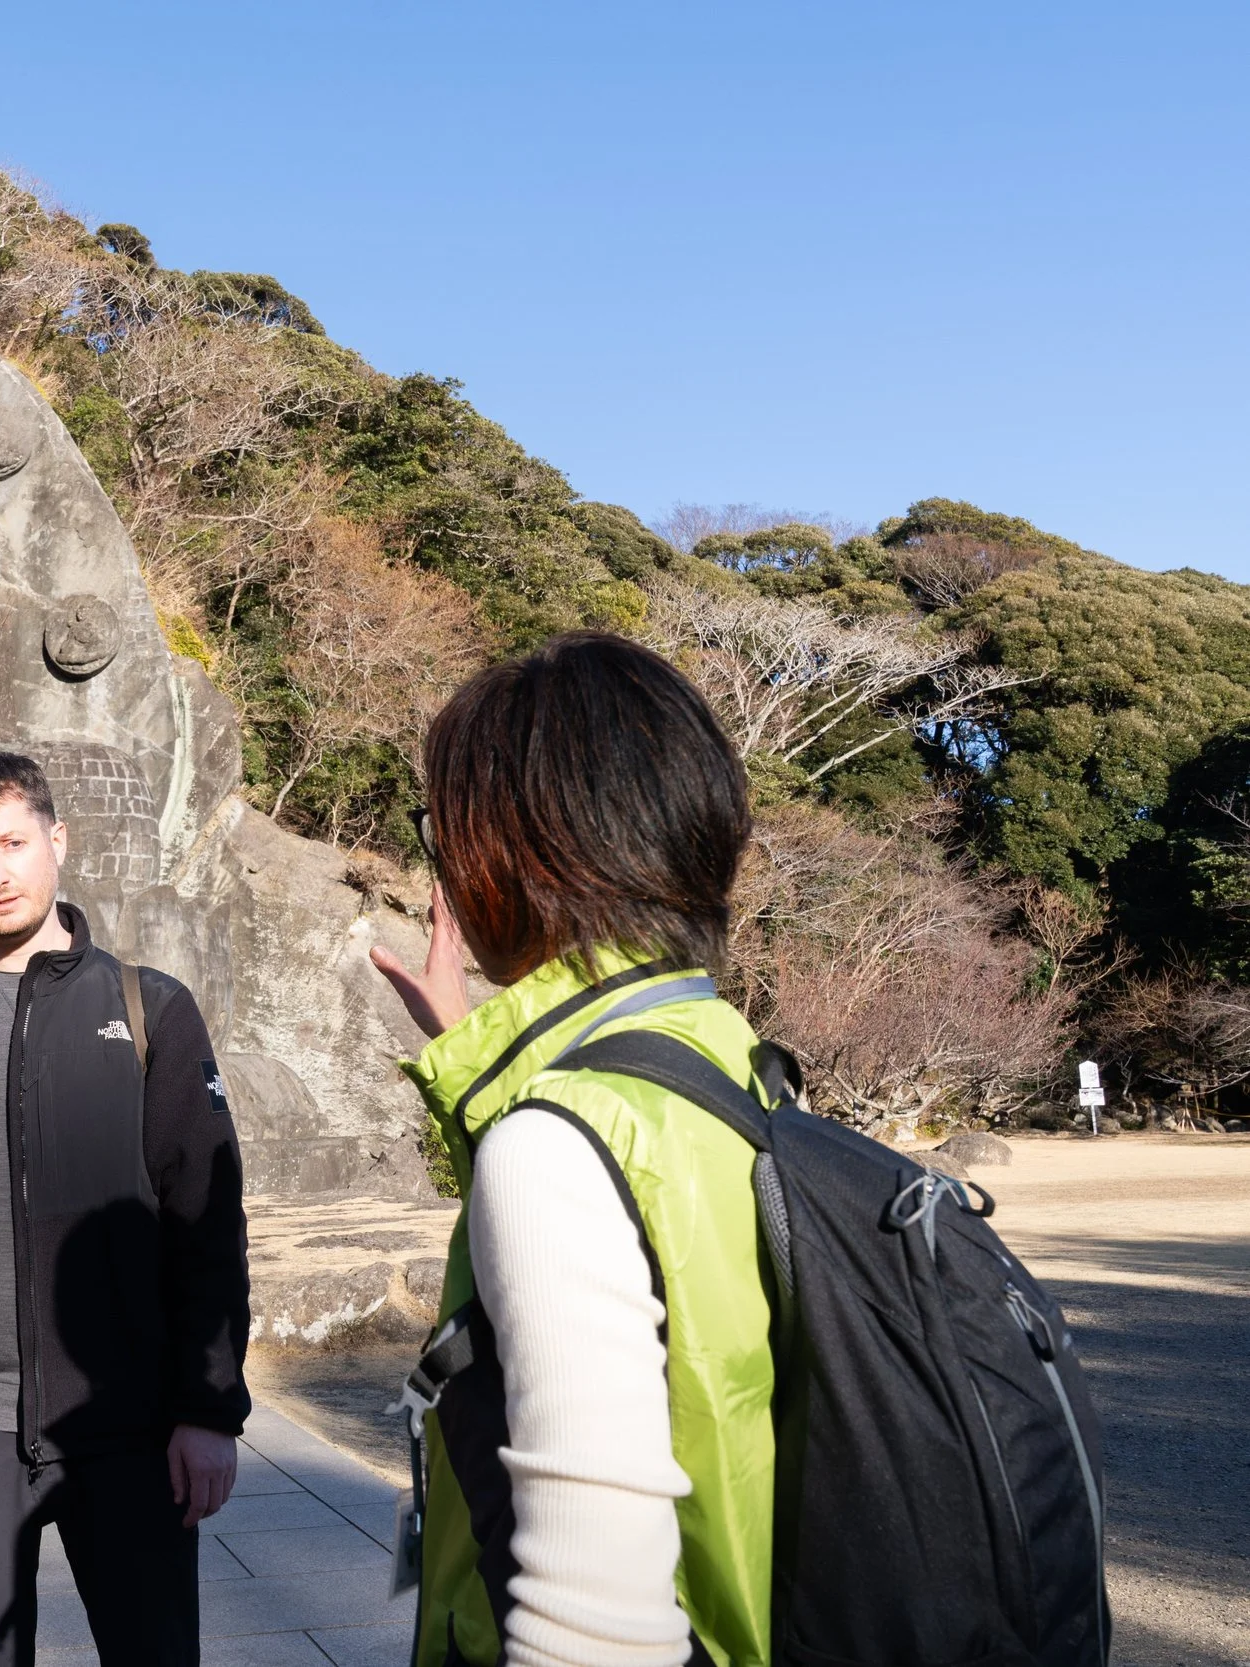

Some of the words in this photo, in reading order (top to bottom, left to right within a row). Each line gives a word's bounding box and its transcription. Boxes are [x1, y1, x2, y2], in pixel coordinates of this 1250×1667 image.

[108, 1020, 123, 1028] THE
[97, 1027, 123, 1036] NORTH
[105, 1032, 123, 1040] FACE
